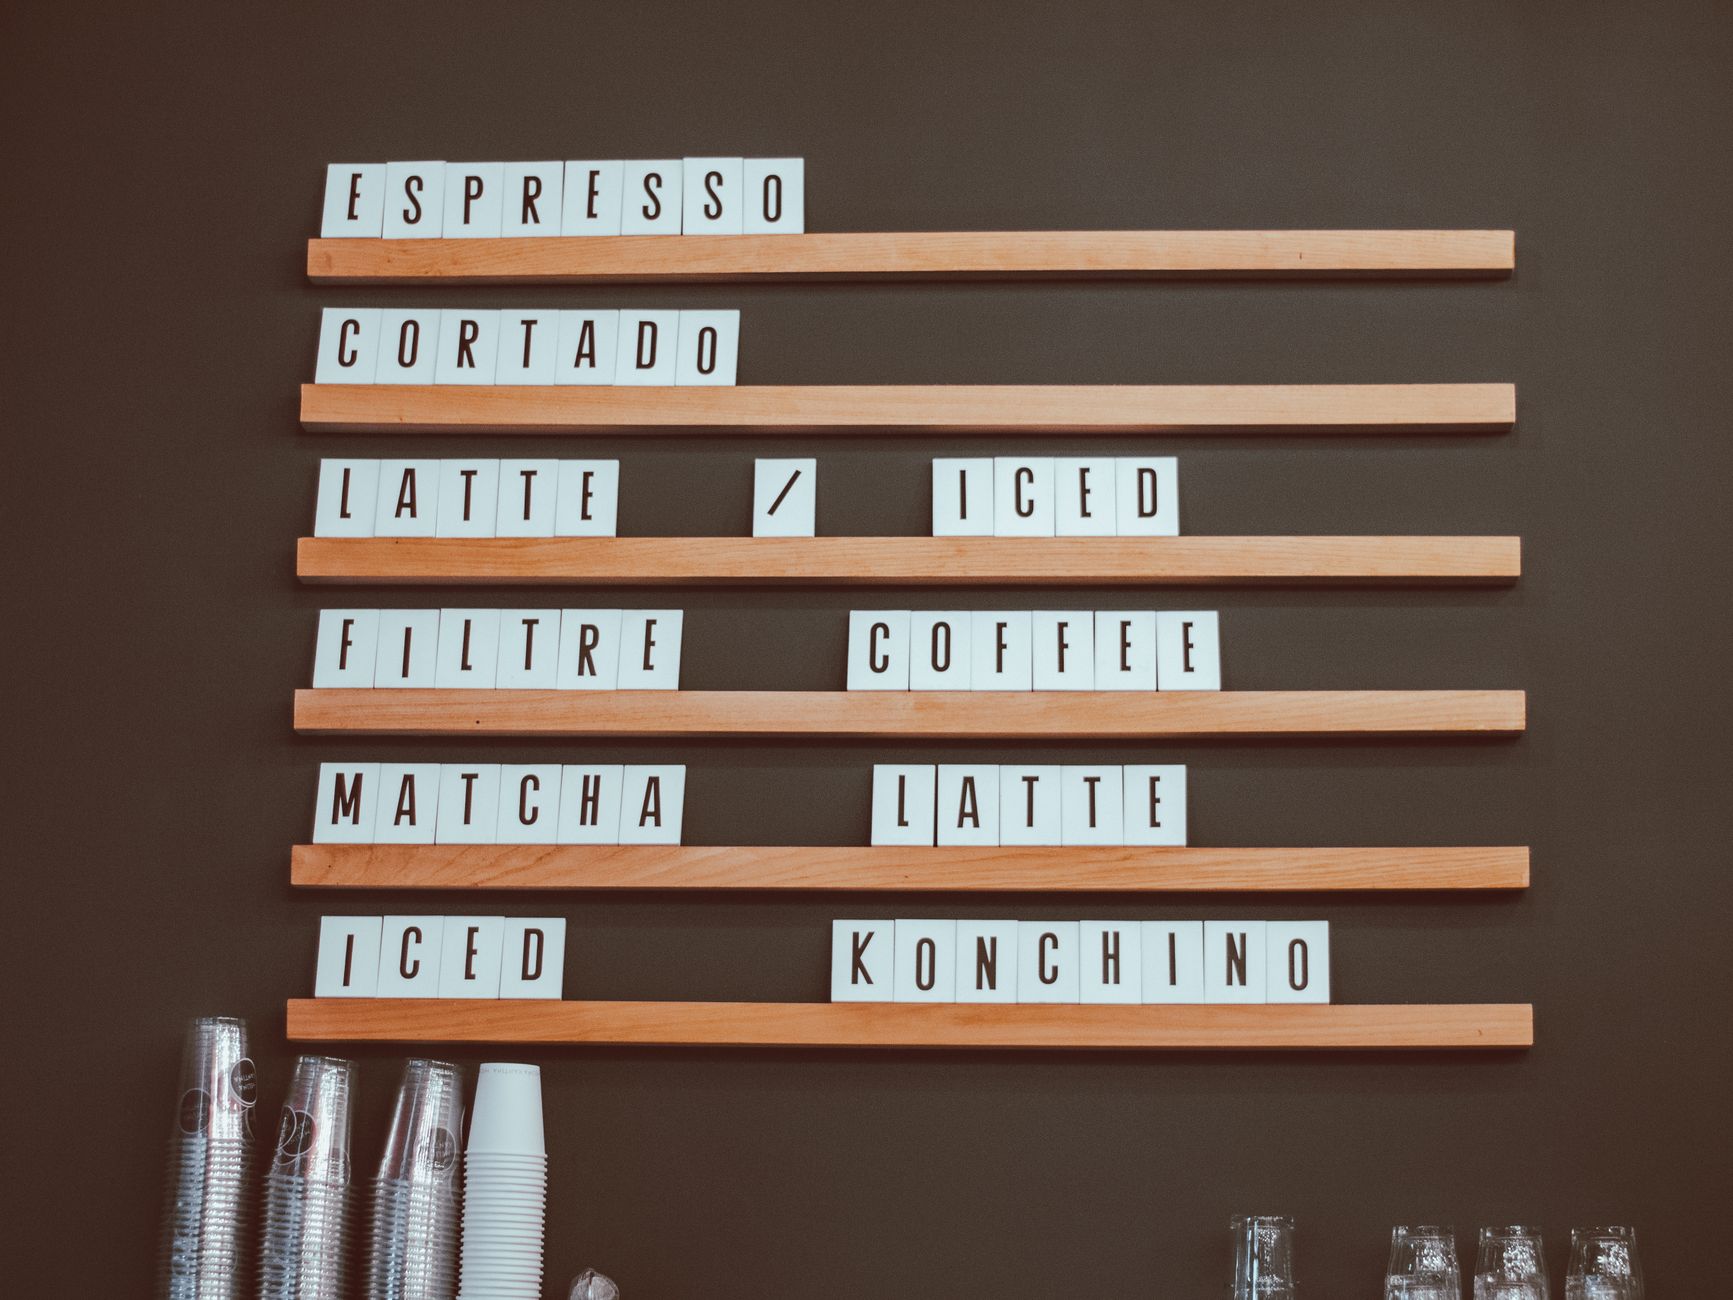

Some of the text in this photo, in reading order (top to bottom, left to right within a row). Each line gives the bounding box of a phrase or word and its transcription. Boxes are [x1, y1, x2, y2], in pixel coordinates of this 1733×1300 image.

[348, 171, 781, 224] ESPRESSO
[338, 319, 717, 374] CORTADO
[340, 468, 1157, 520] LATTE / ICED
[339, 619, 1195, 677] FILTRE COFFEE
[332, 773, 1161, 827] MATCHA LATTE
[343, 927, 1308, 990] ICED KONCHINO
